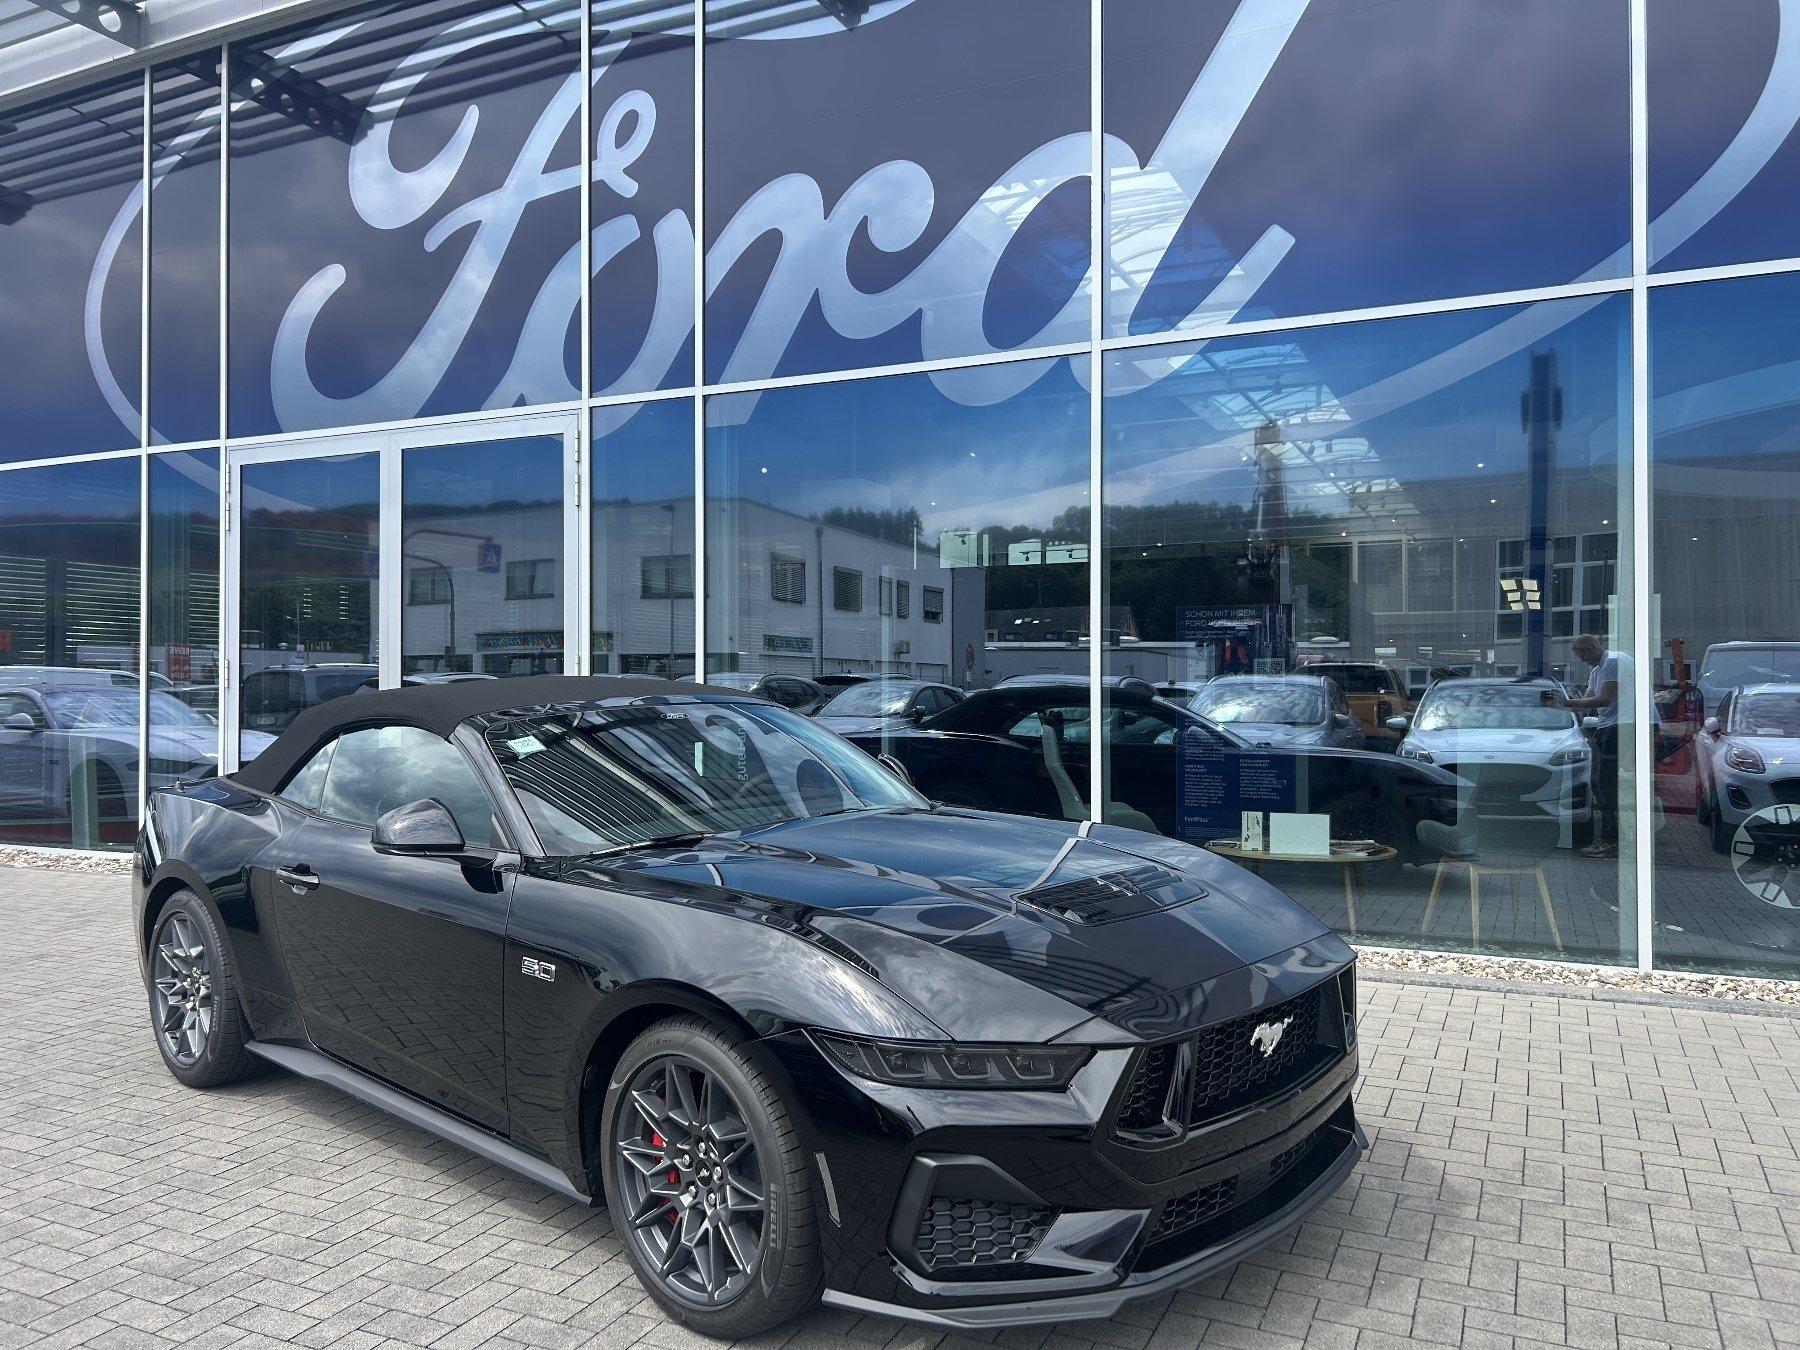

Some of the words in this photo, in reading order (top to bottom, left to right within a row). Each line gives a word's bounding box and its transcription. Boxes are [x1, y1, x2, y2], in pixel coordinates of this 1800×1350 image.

[271, 0, 1303, 460] Ford
[1185, 619, 1207, 627] FORD
[1214, 609, 1230, 617] MIT
[770, 1182, 779, 1248] PIRELLI
